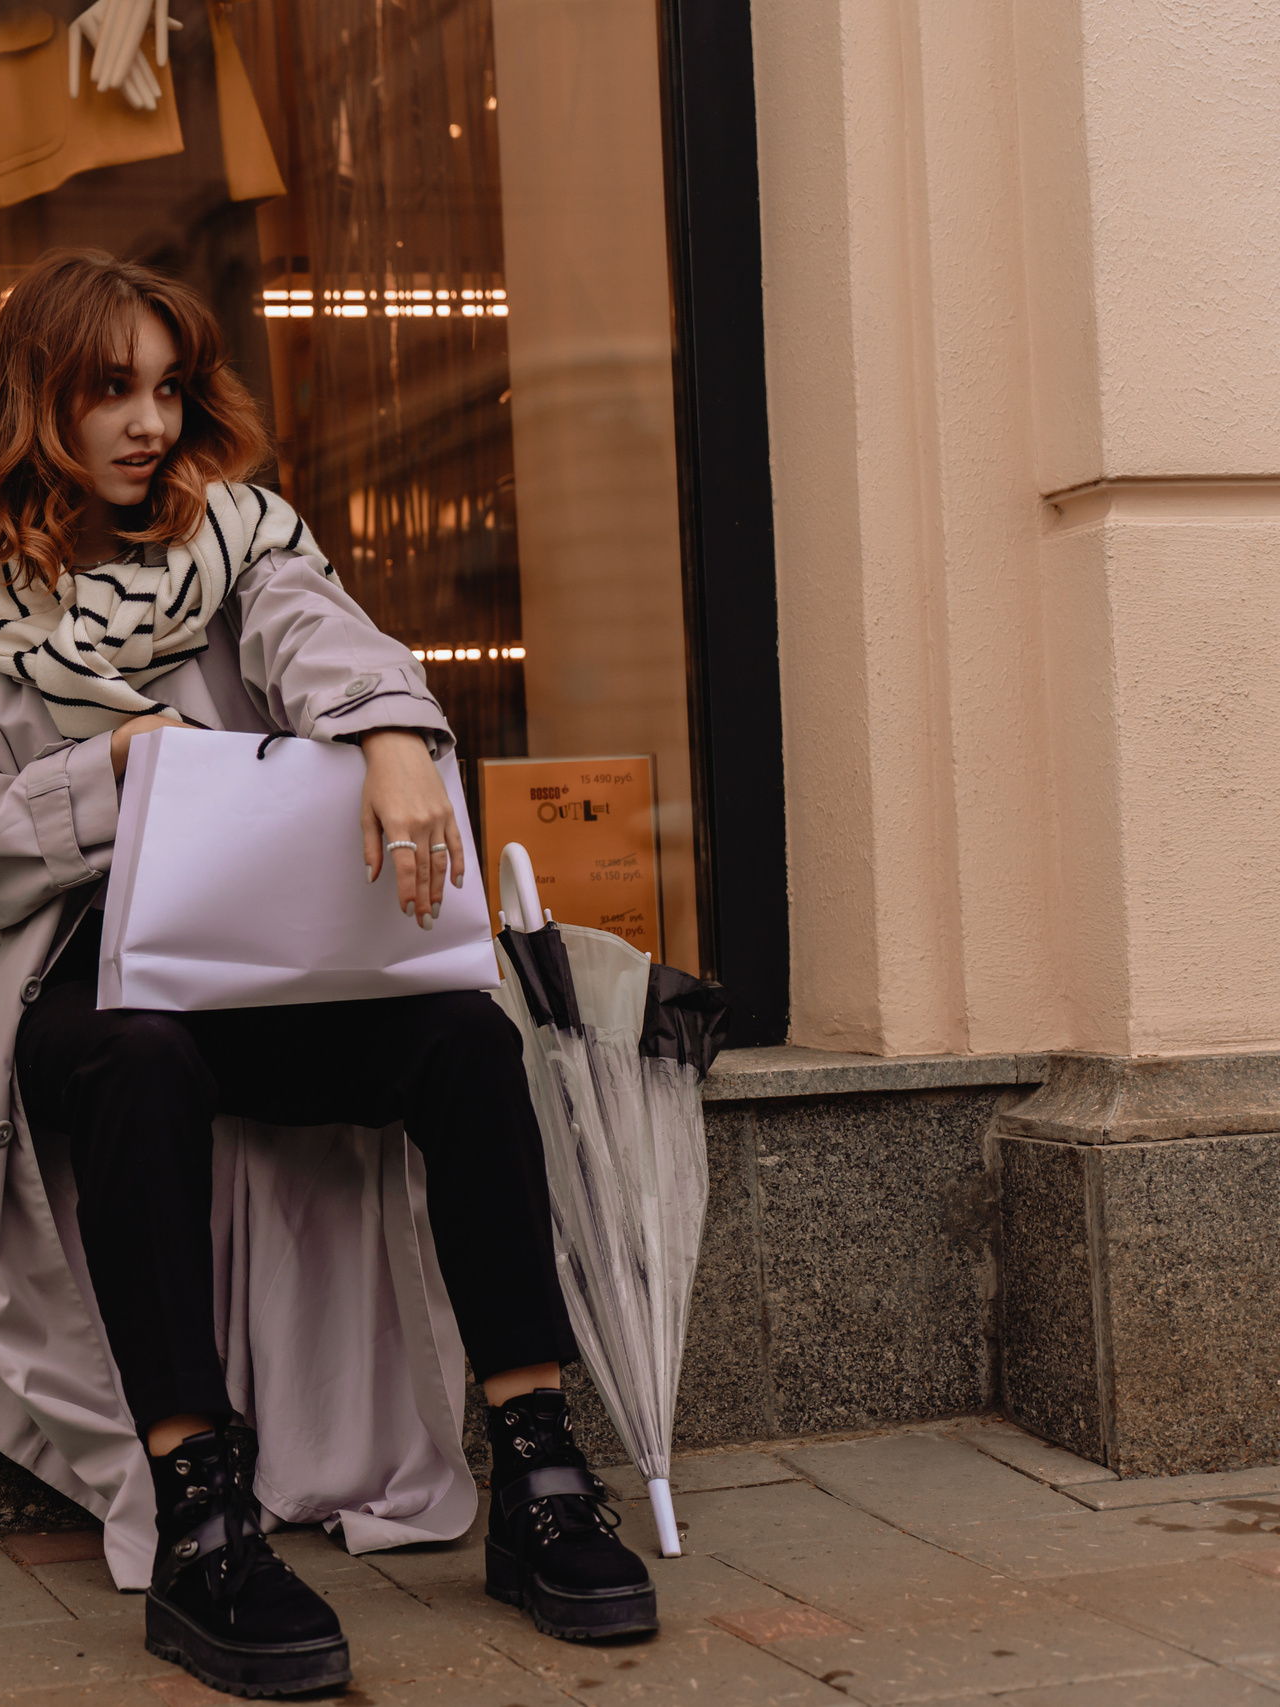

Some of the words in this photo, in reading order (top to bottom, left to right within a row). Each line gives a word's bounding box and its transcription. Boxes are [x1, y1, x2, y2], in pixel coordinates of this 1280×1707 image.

[593, 773, 612, 784] 490
[614, 772, 636, 785] руб.
[530, 786, 561, 801] BOSCO
[590, 871, 602, 882] 56
[605, 871, 621, 881] 150
[623, 869, 644, 882] руб.
[625, 925, 646, 938] руб.
